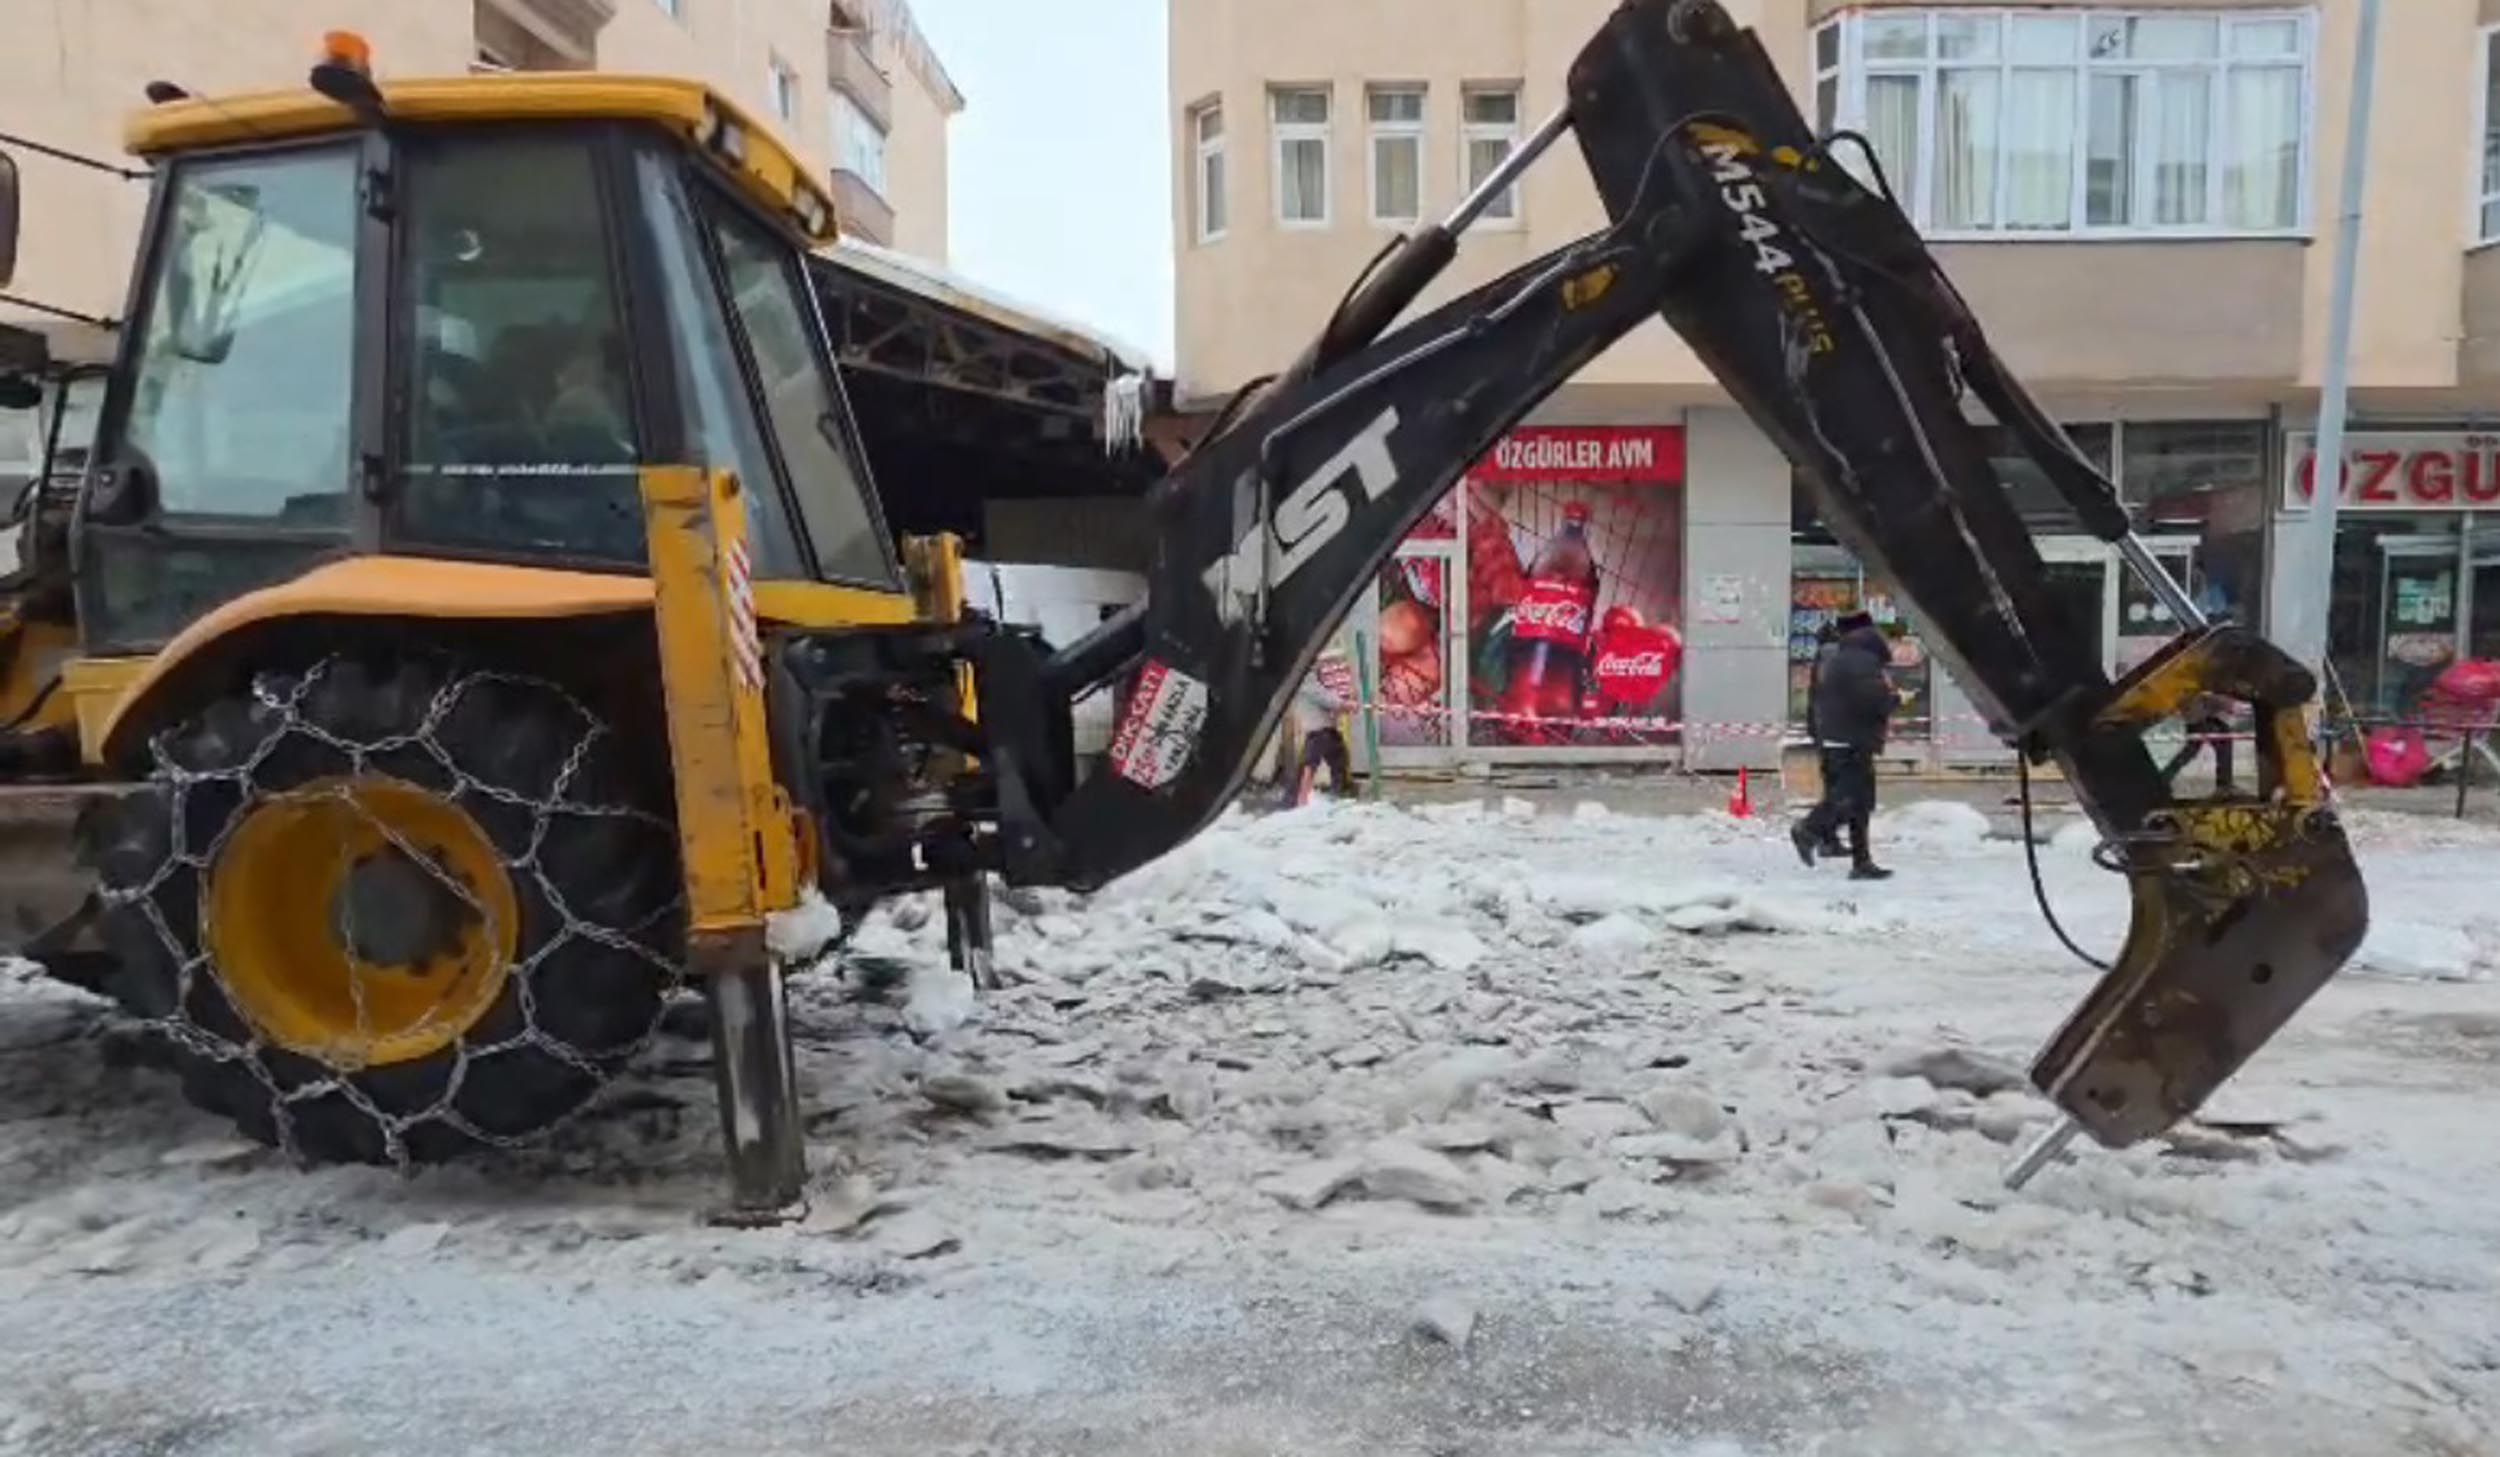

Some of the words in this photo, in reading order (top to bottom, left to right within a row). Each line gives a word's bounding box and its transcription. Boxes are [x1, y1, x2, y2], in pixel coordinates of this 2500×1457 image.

[1701, 143, 1794, 275] M544
[1496, 434, 1601, 470] ÖZGÜRLER
[1606, 437, 1654, 470] AVM
